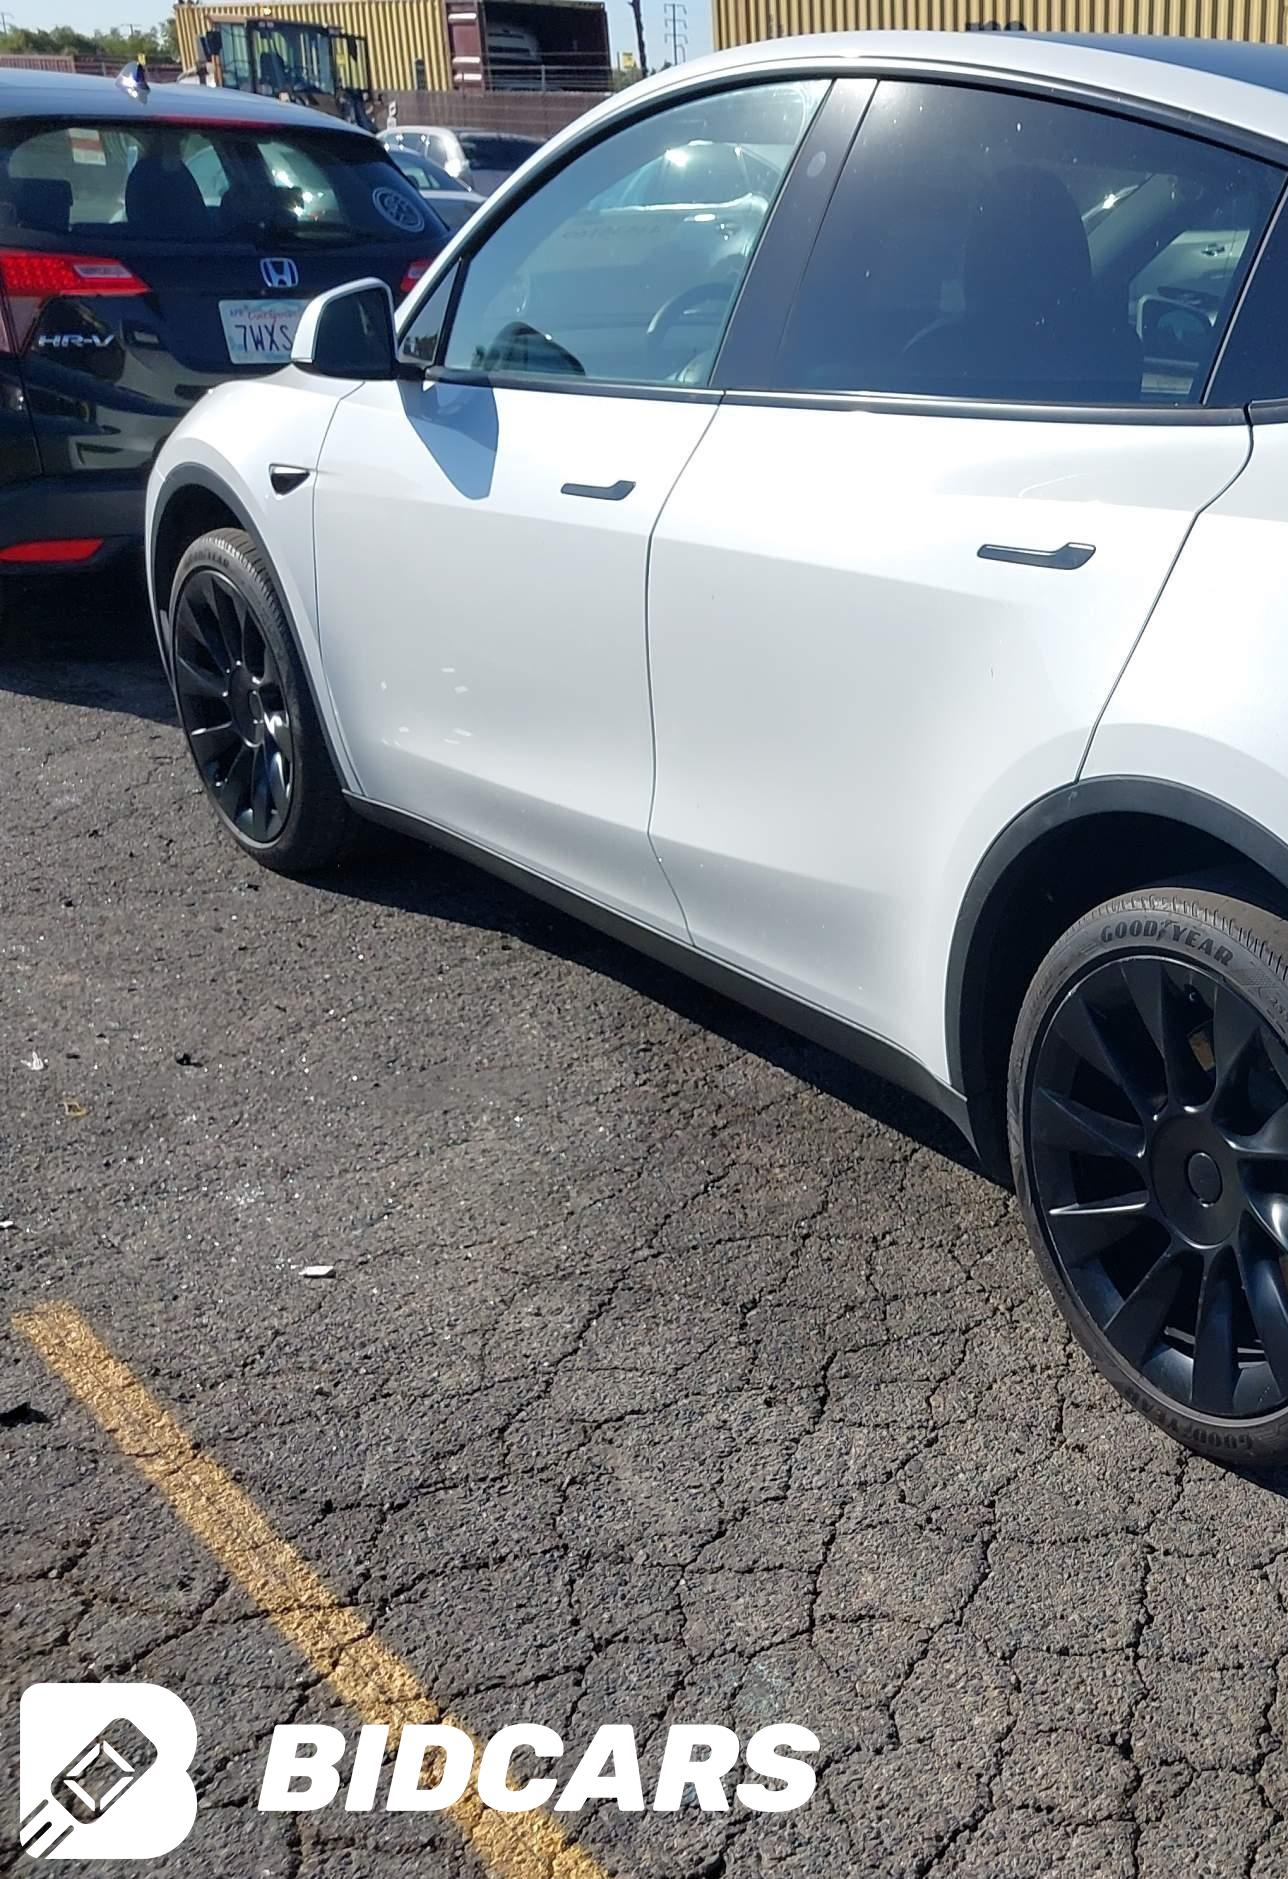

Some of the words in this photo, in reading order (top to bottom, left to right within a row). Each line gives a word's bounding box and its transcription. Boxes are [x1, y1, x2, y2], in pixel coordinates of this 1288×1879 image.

[38, 334, 114, 347] HR-V
[233, 324, 293, 352] 7WXS
[1100, 919, 1234, 966] GOODYEAR
